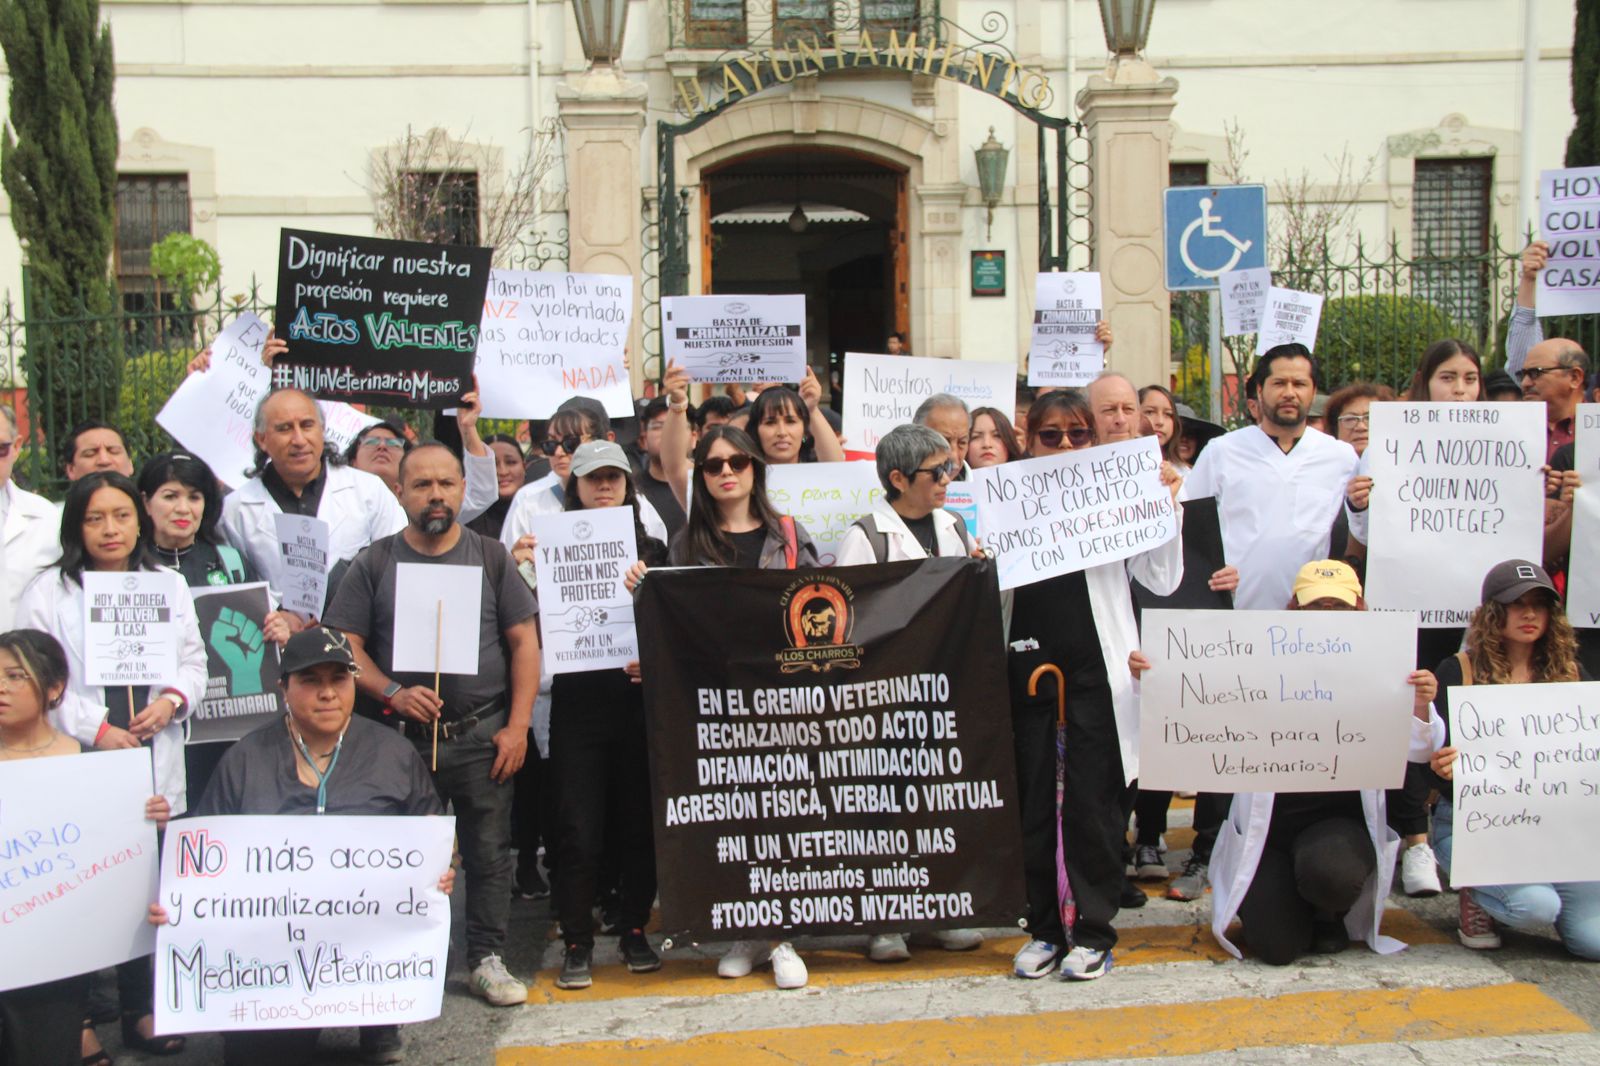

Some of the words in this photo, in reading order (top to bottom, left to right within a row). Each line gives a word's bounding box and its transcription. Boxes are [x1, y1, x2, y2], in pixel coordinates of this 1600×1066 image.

[722, 29, 1049, 109] AYUNTAMIENTO
[1546, 211, 1600, 231] COL
[288, 236, 384, 279] Dignificar
[393, 251, 471, 277] nuestra
[295, 280, 372, 308] profesión
[383, 289, 448, 316] requiere
[595, 285, 621, 297] una
[1056, 299, 1075, 309] BASTA
[1076, 299, 1083, 308] DE
[531, 299, 625, 324] violentada
[712, 318, 747, 327] BASTA
[749, 317, 762, 326] DE
[1041, 310, 1096, 323] CRIMINALIZAR
[365, 312, 477, 350] VALIENTES
[518, 320, 619, 346] autoridades
[684, 339, 732, 349] NUESTRA
[688, 326, 788, 339] CRIMINALIZAR
[225, 345, 258, 378] para
[500, 350, 564, 367] hicieron
[274, 364, 460, 400] #NiUnVeterinarioMenos
[562, 365, 617, 390] NADA
[863, 367, 934, 396] Nuestros
[944, 373, 993, 395] derechos
[862, 398, 913, 421] nuestra
[1403, 409, 1421, 424] 18
[1428, 409, 1441, 423] DE
[1449, 409, 1500, 424] FEBRERO
[1409, 440, 1427, 465] A
[1436, 438, 1532, 469] NOSOTROS,
[985, 467, 1017, 504] NO
[1021, 463, 1085, 498] SOMOS
[1465, 478, 1498, 504] NOS
[801, 488, 842, 507] para
[1021, 494, 1051, 520] DE
[1061, 479, 1143, 513] CUENTO,
[987, 526, 1043, 558] SOMOS
[1050, 495, 1173, 544] PROFESIONALES
[1410, 508, 1505, 534] PROTEGE?
[542, 547, 551, 564] Y
[554, 549, 562, 563] A
[564, 541, 629, 561] NOSOTROS,
[1031, 546, 1065, 571] CON
[1079, 521, 1167, 559] DERECHOS
[595, 562, 620, 580] NOS
[94, 593, 116, 607] HOY,
[118, 594, 131, 606] UN
[134, 594, 167, 606] COLEGA
[561, 582, 617, 602] PROTEGE?
[102, 608, 115, 622] NO
[115, 624, 121, 636] A
[123, 624, 147, 636] CASA
[574, 635, 595, 650] #NI
[598, 633, 613, 647] UN
[1167, 627, 1253, 660] Nuestra
[1266, 625, 1353, 656] Profesión
[136, 662, 147, 671] UN
[555, 649, 605, 662] VETERINARIO
[607, 646, 634, 657] MENOS
[784, 651, 804, 661] LOS
[806, 648, 855, 660] CHARROS
[697, 688, 723, 715] EN
[726, 689, 750, 716] EL
[753, 686, 825, 715] GREMIO
[829, 673, 950, 712] VETERINATIO
[1181, 672, 1268, 708] Nuestra
[1279, 674, 1333, 702] Lucha
[697, 721, 822, 750] RECHAZAMOS
[824, 714, 877, 744] TODO
[882, 711, 928, 740] ACTO
[932, 711, 958, 740] DE
[1164, 716, 1258, 745] ¡Derechos
[1270, 730, 1320, 746] para
[1336, 720, 1367, 744] los
[1459, 701, 1506, 741] Que
[697, 747, 815, 786] DIFAMACIÓN,
[819, 741, 945, 779] INTIMIDACIÓN
[949, 747, 963, 775] O
[1212, 753, 1339, 780] Veterinarios!
[1459, 751, 1486, 775] no
[1496, 750, 1522, 770] se
[1514, 778, 1532, 795] de
[1542, 781, 1568, 796] un
[665, 787, 759, 827] AGRESIÓN
[760, 784, 828, 821] FÍSICA,
[830, 784, 902, 814] VERBAL
[905, 784, 919, 813] O
[922, 780, 1004, 812] VIRTUAL
[1466, 808, 1543, 833] escucha
[177, 830, 228, 877] No
[246, 838, 313, 873] más
[330, 848, 424, 868] acoso
[716, 827, 957, 864] #NI_UN_VETERINARIO_MAS
[749, 861, 930, 894] #Veterinarios_unidos
[168, 891, 182, 926] y
[193, 888, 381, 919] criminalización
[396, 887, 429, 917] de
[711, 888, 974, 930] #TODOS_SOMOS_MVZHÉCTOR
[287, 922, 305, 942] la
[169, 941, 291, 1012] Medicina
[297, 942, 435, 993] Veterinaria
